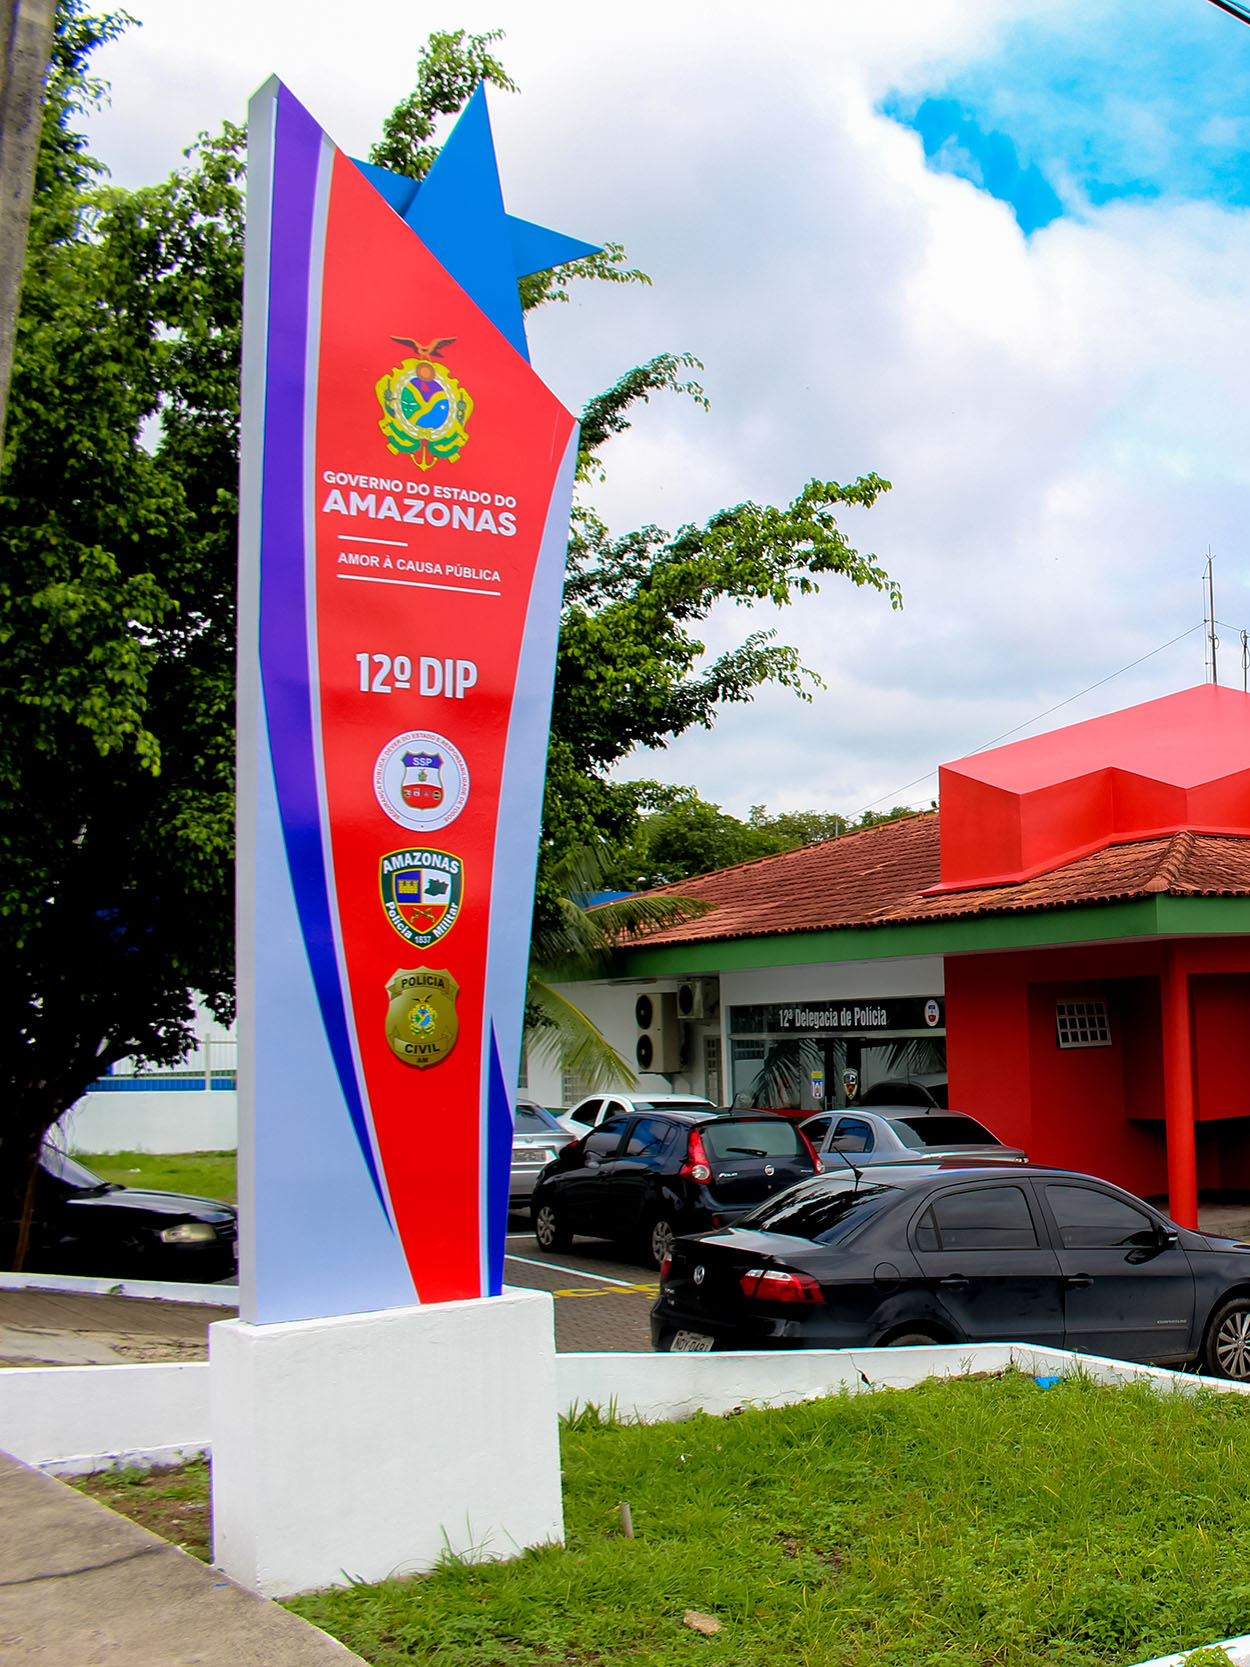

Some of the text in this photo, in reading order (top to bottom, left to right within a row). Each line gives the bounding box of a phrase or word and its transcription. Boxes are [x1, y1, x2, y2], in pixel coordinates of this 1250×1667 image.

[323, 470, 517, 508] GOVERNO DO ESTADO DO
[322, 489, 517, 536] AMAZONAS
[337, 552, 501, 582] AMOR À CAUSA PÚBLICA
[419, 656, 478, 699] DIP
[412, 757, 432, 766] SSP
[383, 852, 460, 874] AMAZONAS
[432, 902, 459, 938] Militar
[795, 1008, 837, 1029] Delegacia
[840, 1008, 852, 1027] de
[854, 1006, 887, 1026] Polícia
[405, 1044, 440, 1054] CIVIL
